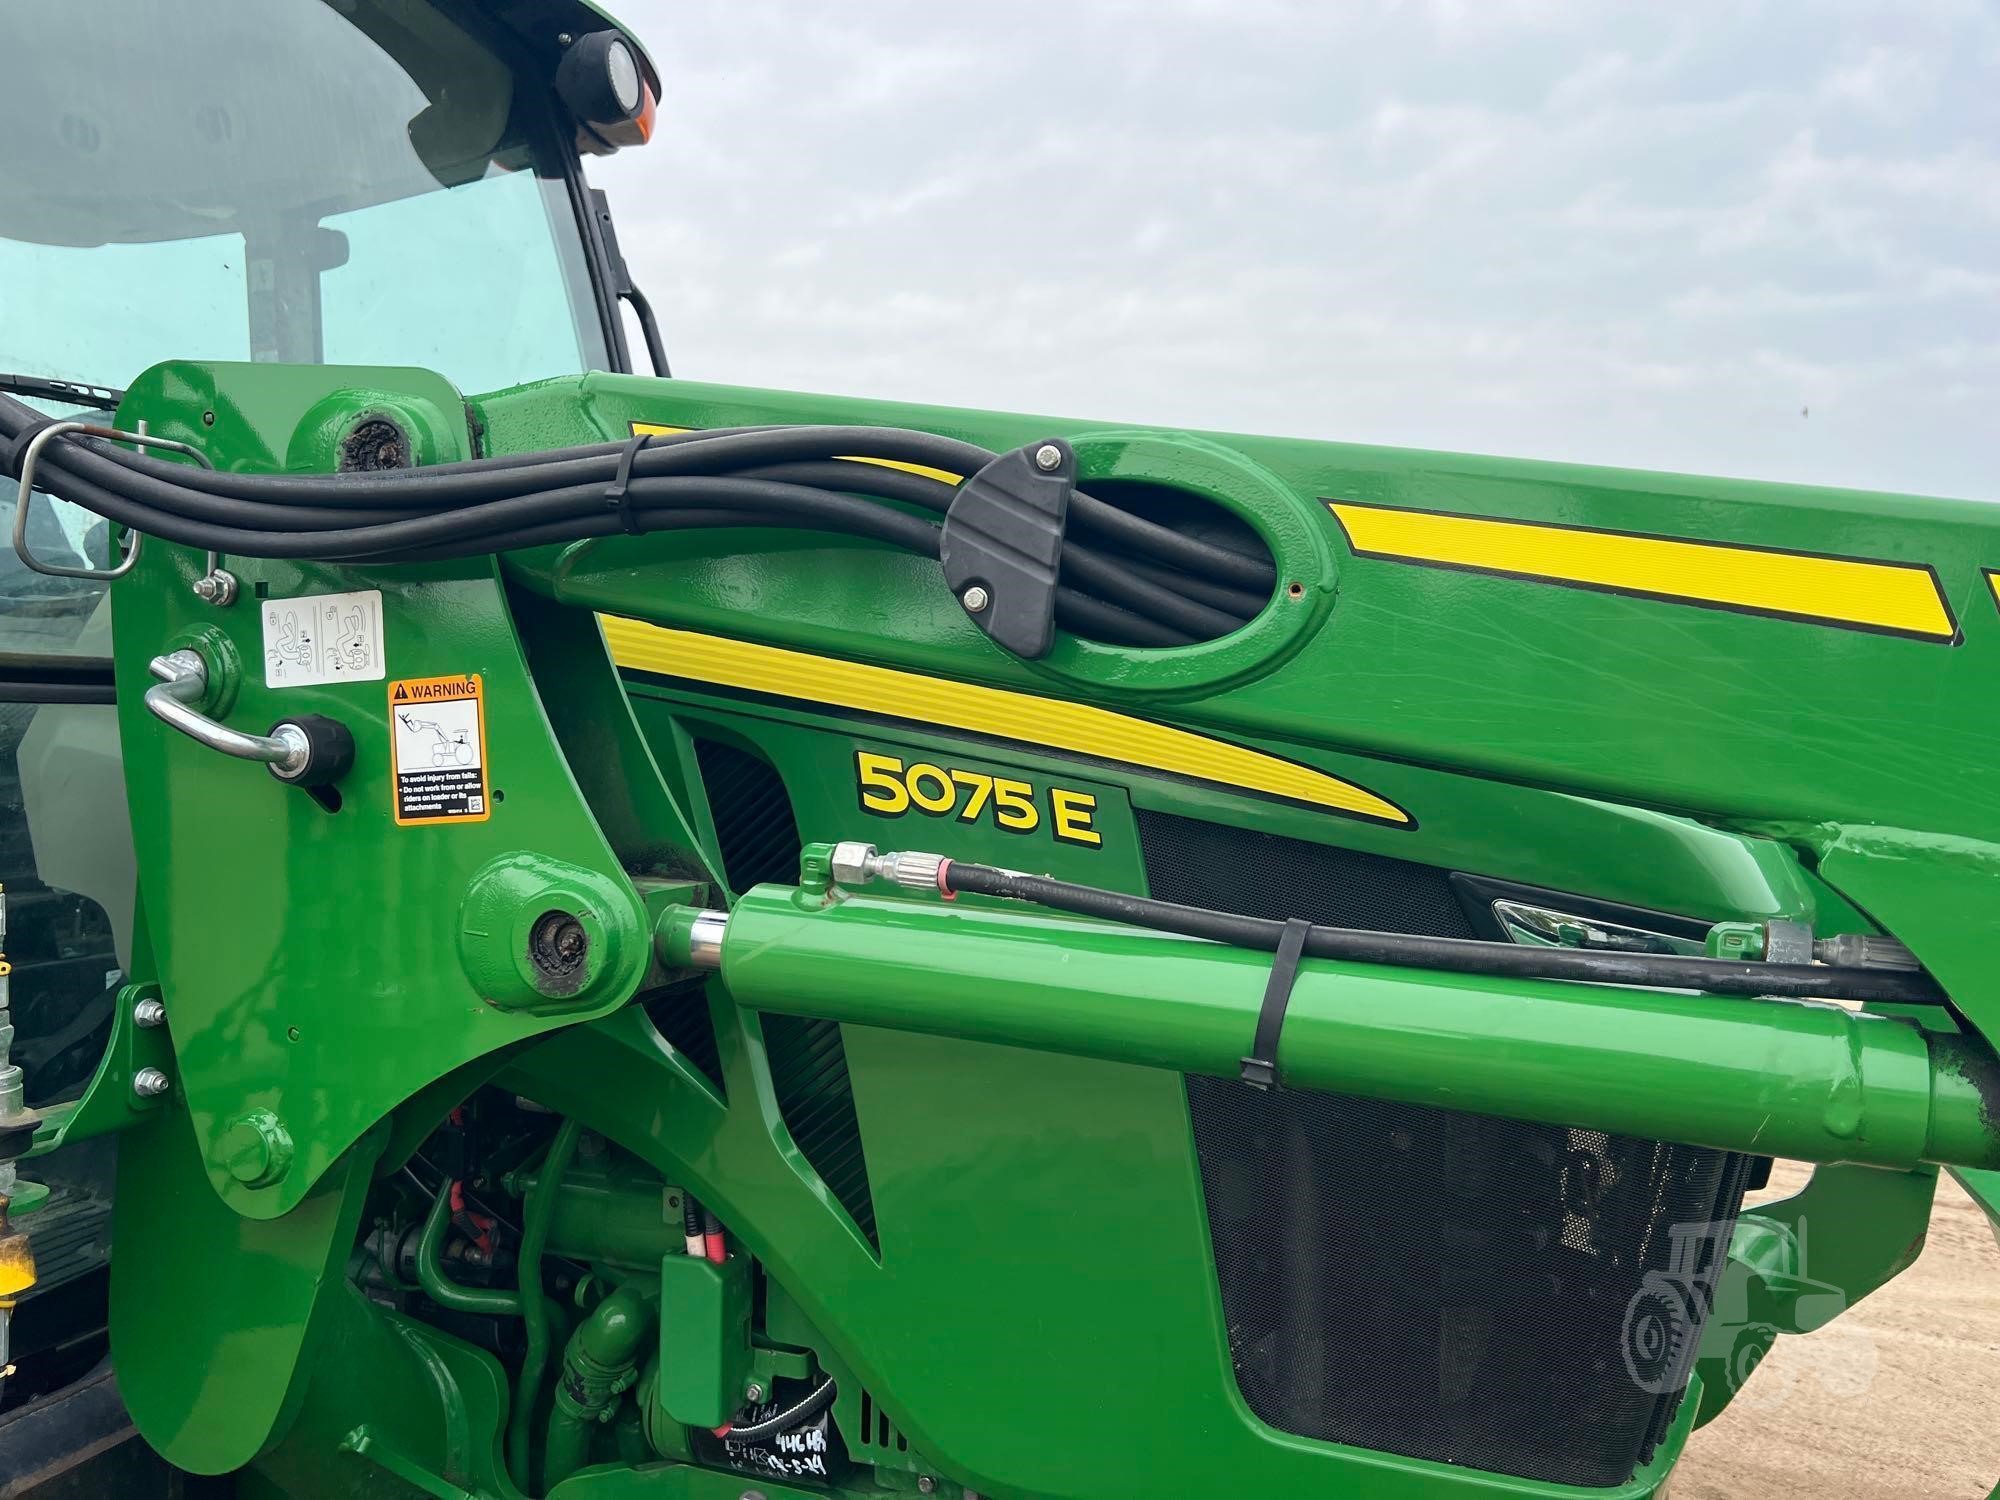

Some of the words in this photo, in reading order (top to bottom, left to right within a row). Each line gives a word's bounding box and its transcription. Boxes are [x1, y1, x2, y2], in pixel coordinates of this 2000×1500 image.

[412, 682, 476, 698] WARNING
[428, 774, 445, 782] injury
[855, 750, 1039, 834] 5075
[1047, 786, 1102, 850] E
[404, 803, 442, 811] attachments
